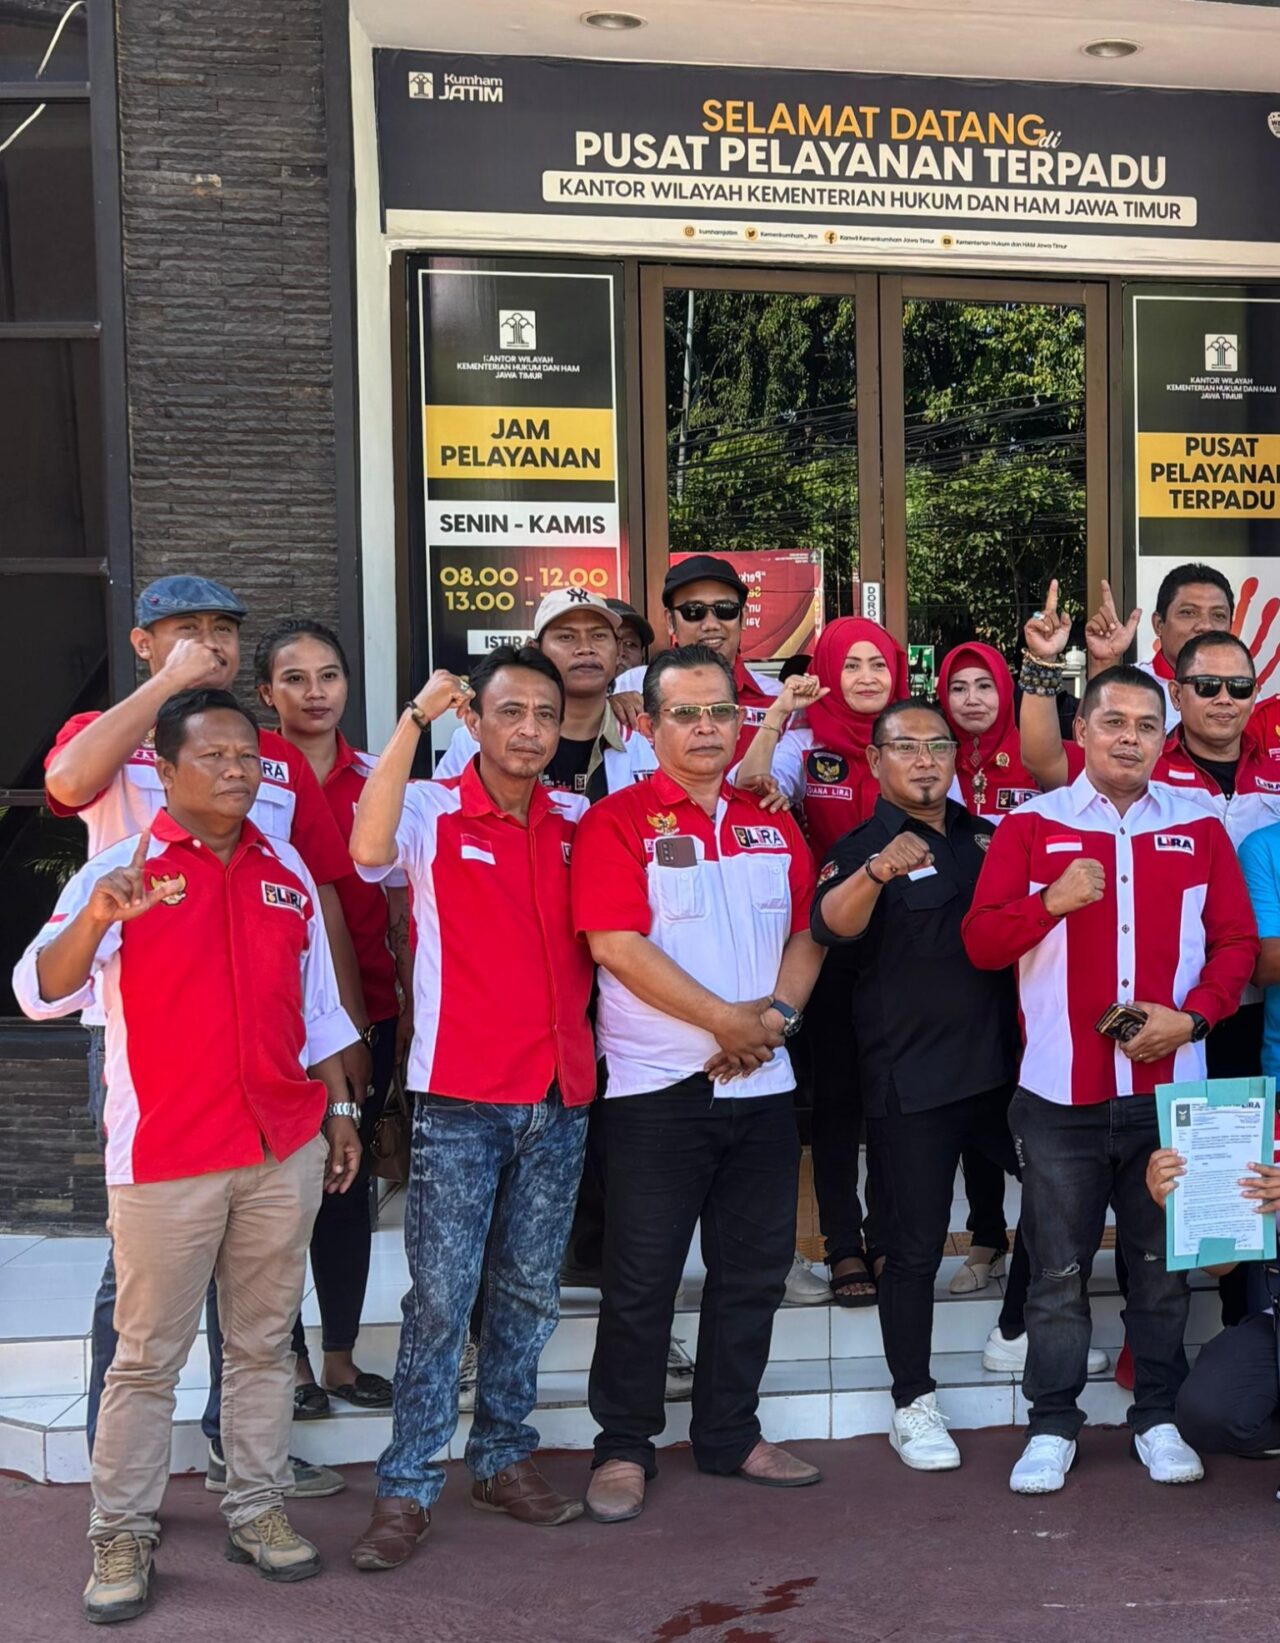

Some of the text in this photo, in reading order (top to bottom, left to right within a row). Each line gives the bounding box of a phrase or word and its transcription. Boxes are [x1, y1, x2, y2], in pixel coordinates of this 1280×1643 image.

[444, 73, 503, 87] Kumham
[439, 85, 503, 102] JATIM
[702, 99, 1063, 149] SELAMAT DATANG di
[576, 131, 1167, 190] PUSAT PELAYANAN TERPADU
[559, 178, 1182, 220] KANTOR WILAYAH KEMENTERIAN HUKUM DAN HAM JAWA TIMUR
[457, 362, 580, 373] KEMENTERIAN HUKUM DAN HAM
[483, 355, 553, 364] KANTOR WILAYAH
[495, 371, 543, 380] JAWA TIMUR
[1190, 376, 1253, 385] KANTOR WILAYAH
[1166, 384, 1215, 392] KEMENTERIAN
[1216, 385, 1242, 393] HUKUM
[1243, 385, 1259, 393] DAN
[1200, 392, 1243, 400] JAWA TIMUR
[491, 419, 550, 440] JAM
[441, 445, 601, 469] PELAYANAN
[1186, 437, 1259, 457] PUSAT
[1169, 489, 1275, 510] TERPADU
[440, 514, 508, 533] SENIN
[529, 515, 606, 534] KAMIS
[439, 567, 519, 587] 08.00
[539, 567, 609, 587] 12.00
[444, 591, 515, 611] 13.00
[867, 586, 877, 618] DORO
